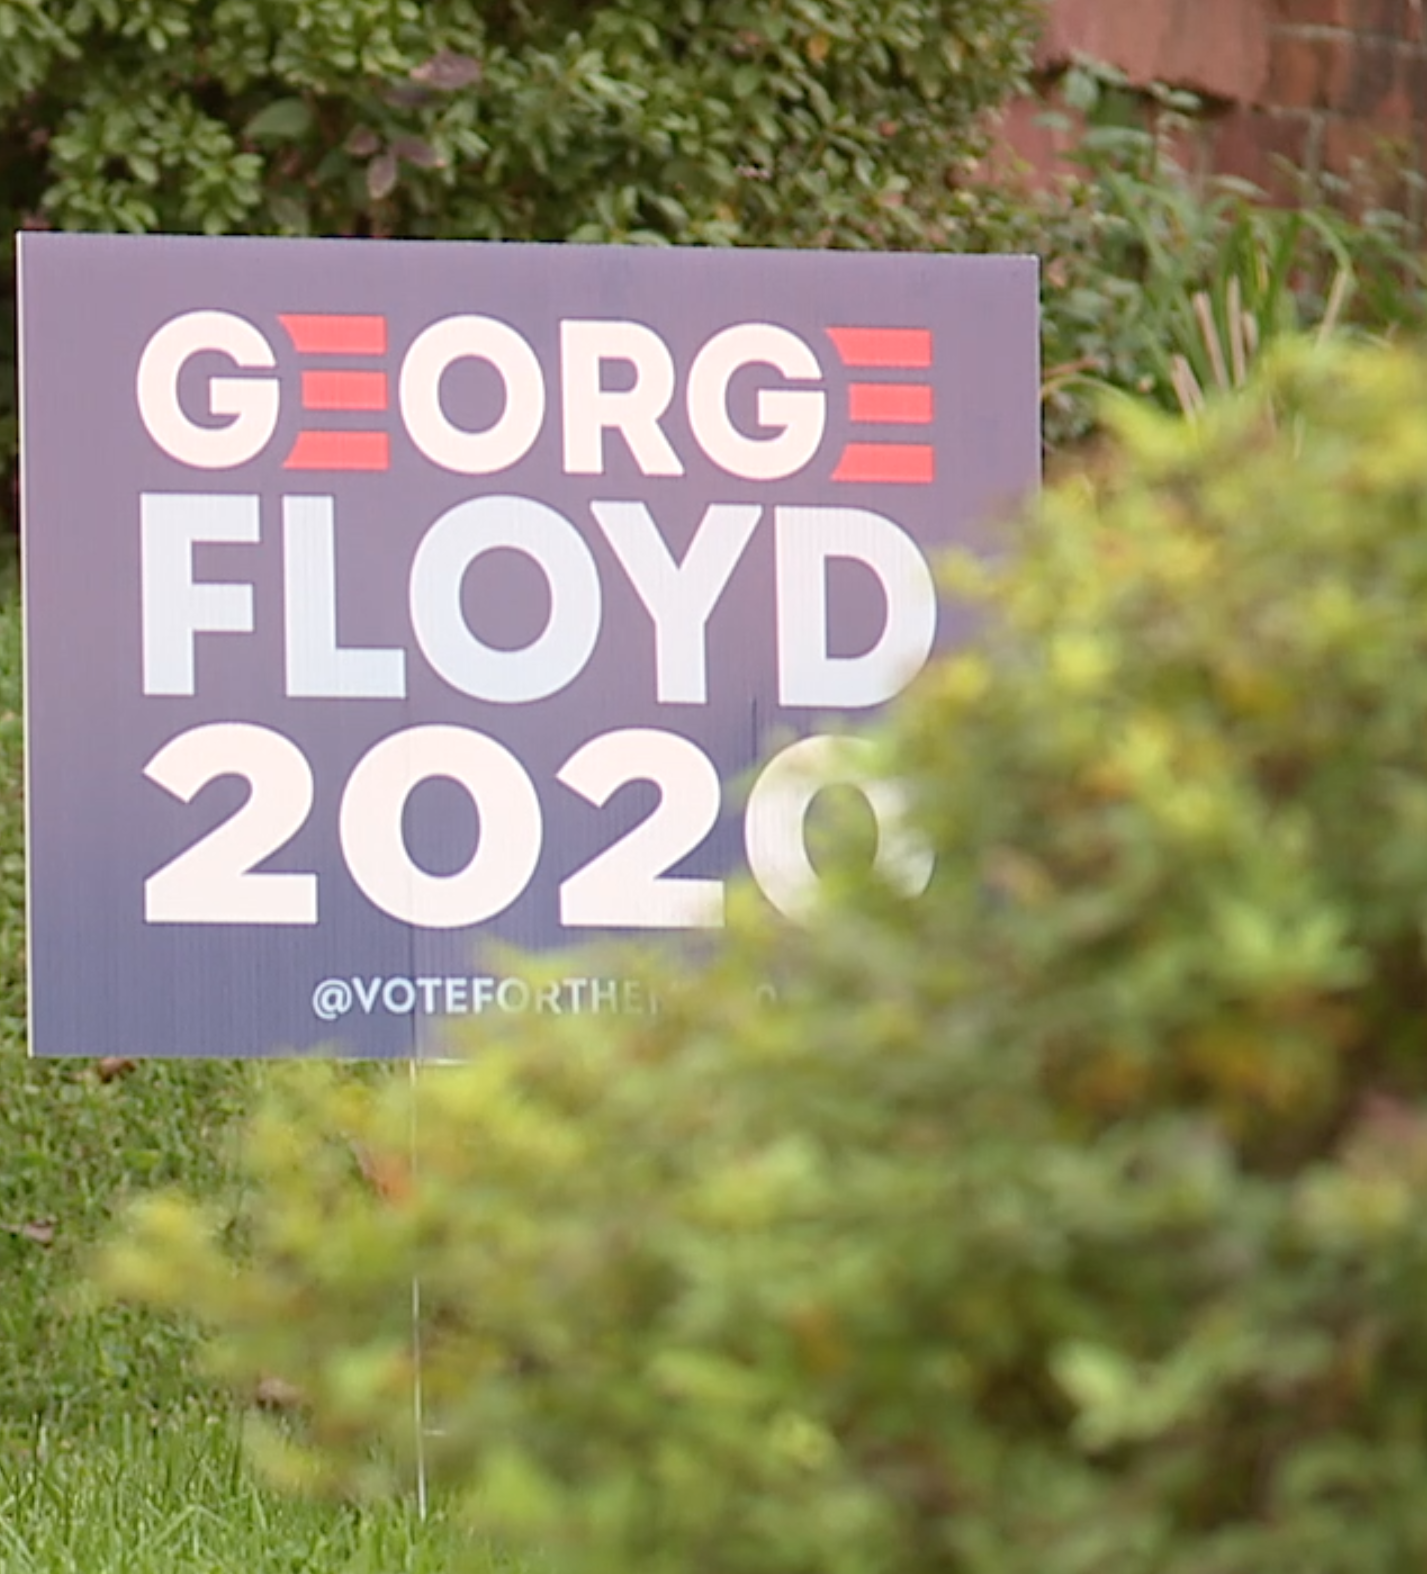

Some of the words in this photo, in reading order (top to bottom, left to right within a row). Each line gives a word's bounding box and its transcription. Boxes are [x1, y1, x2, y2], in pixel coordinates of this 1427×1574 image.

[136, 309, 936, 485] GEORGE
[139, 493, 938, 708] FLOYD
[142, 722, 937, 930] 2020
[311, 976, 779, 1020] @VOTEFORTHE
